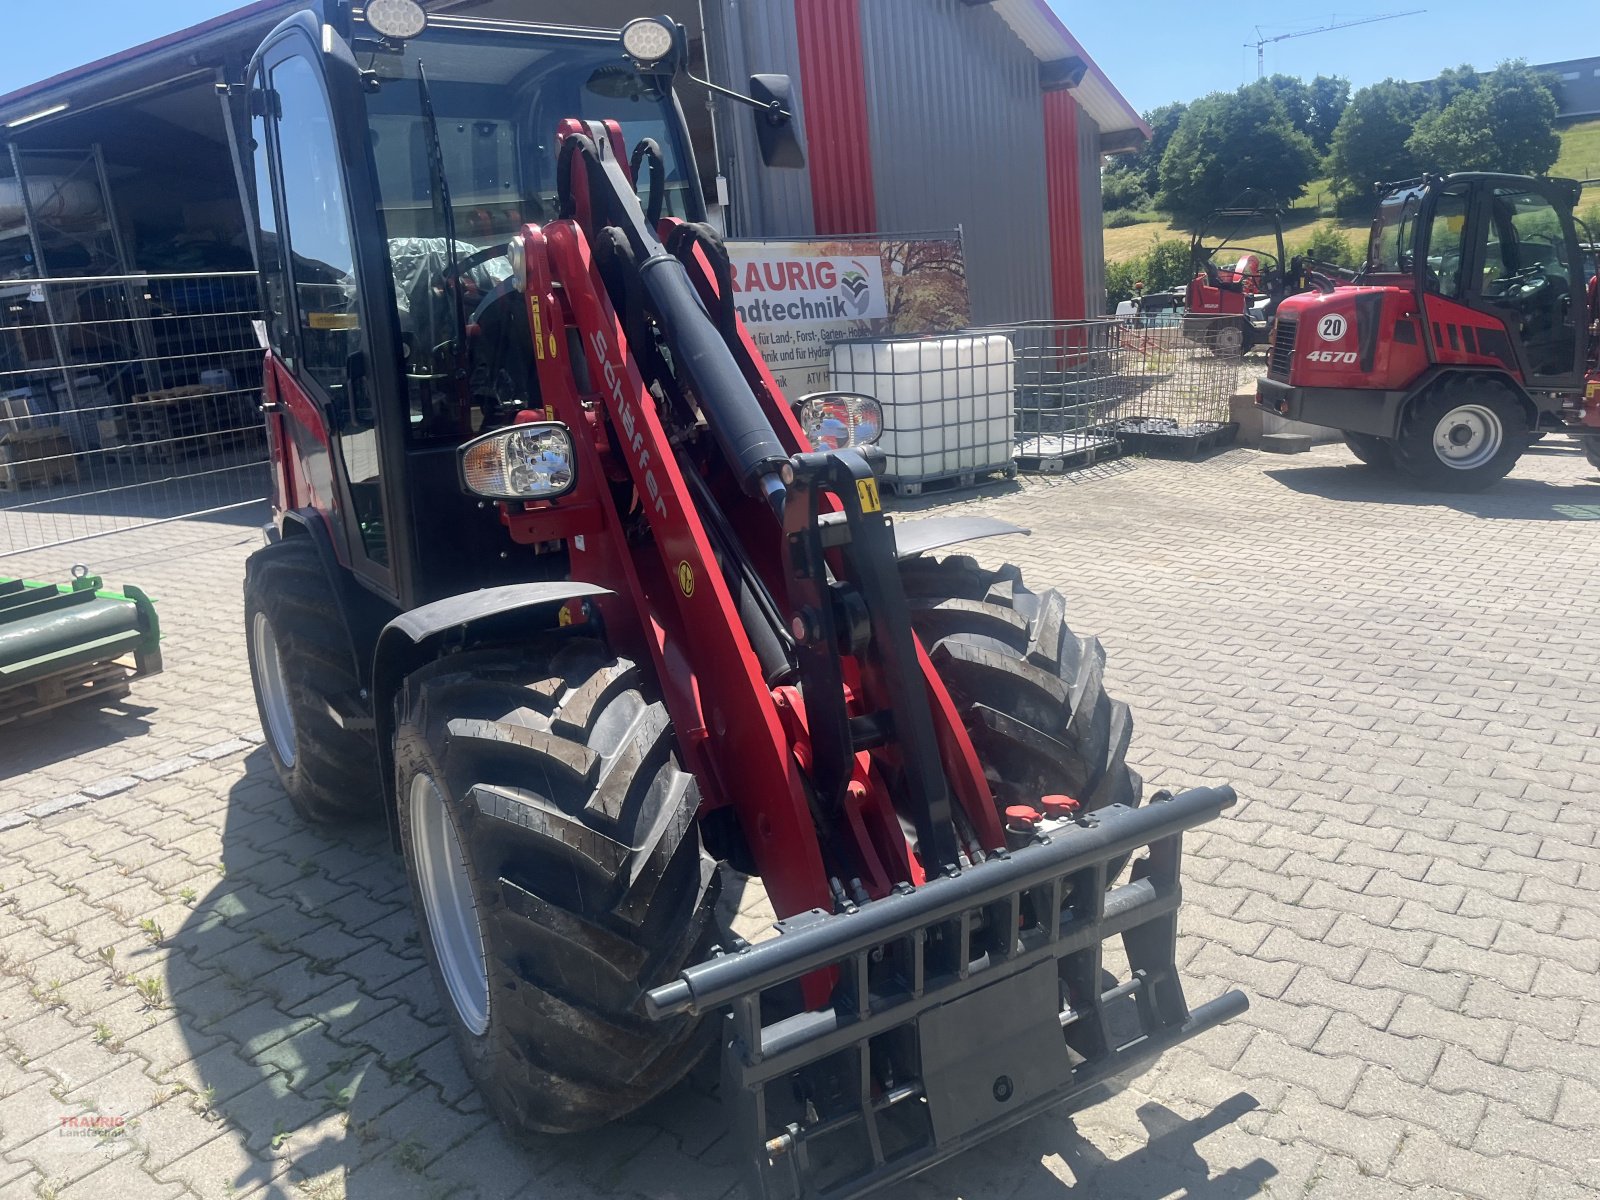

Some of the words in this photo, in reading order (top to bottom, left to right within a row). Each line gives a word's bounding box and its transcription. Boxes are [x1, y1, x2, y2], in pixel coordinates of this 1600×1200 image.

[1323, 319, 1342, 336] 20
[759, 332, 770, 345] für
[780, 347, 795, 361] und
[796, 347, 807, 360] für
[1306, 350, 1358, 363] 4670
[807, 372, 821, 385] ATV
[589, 329, 667, 519] Schäffer
